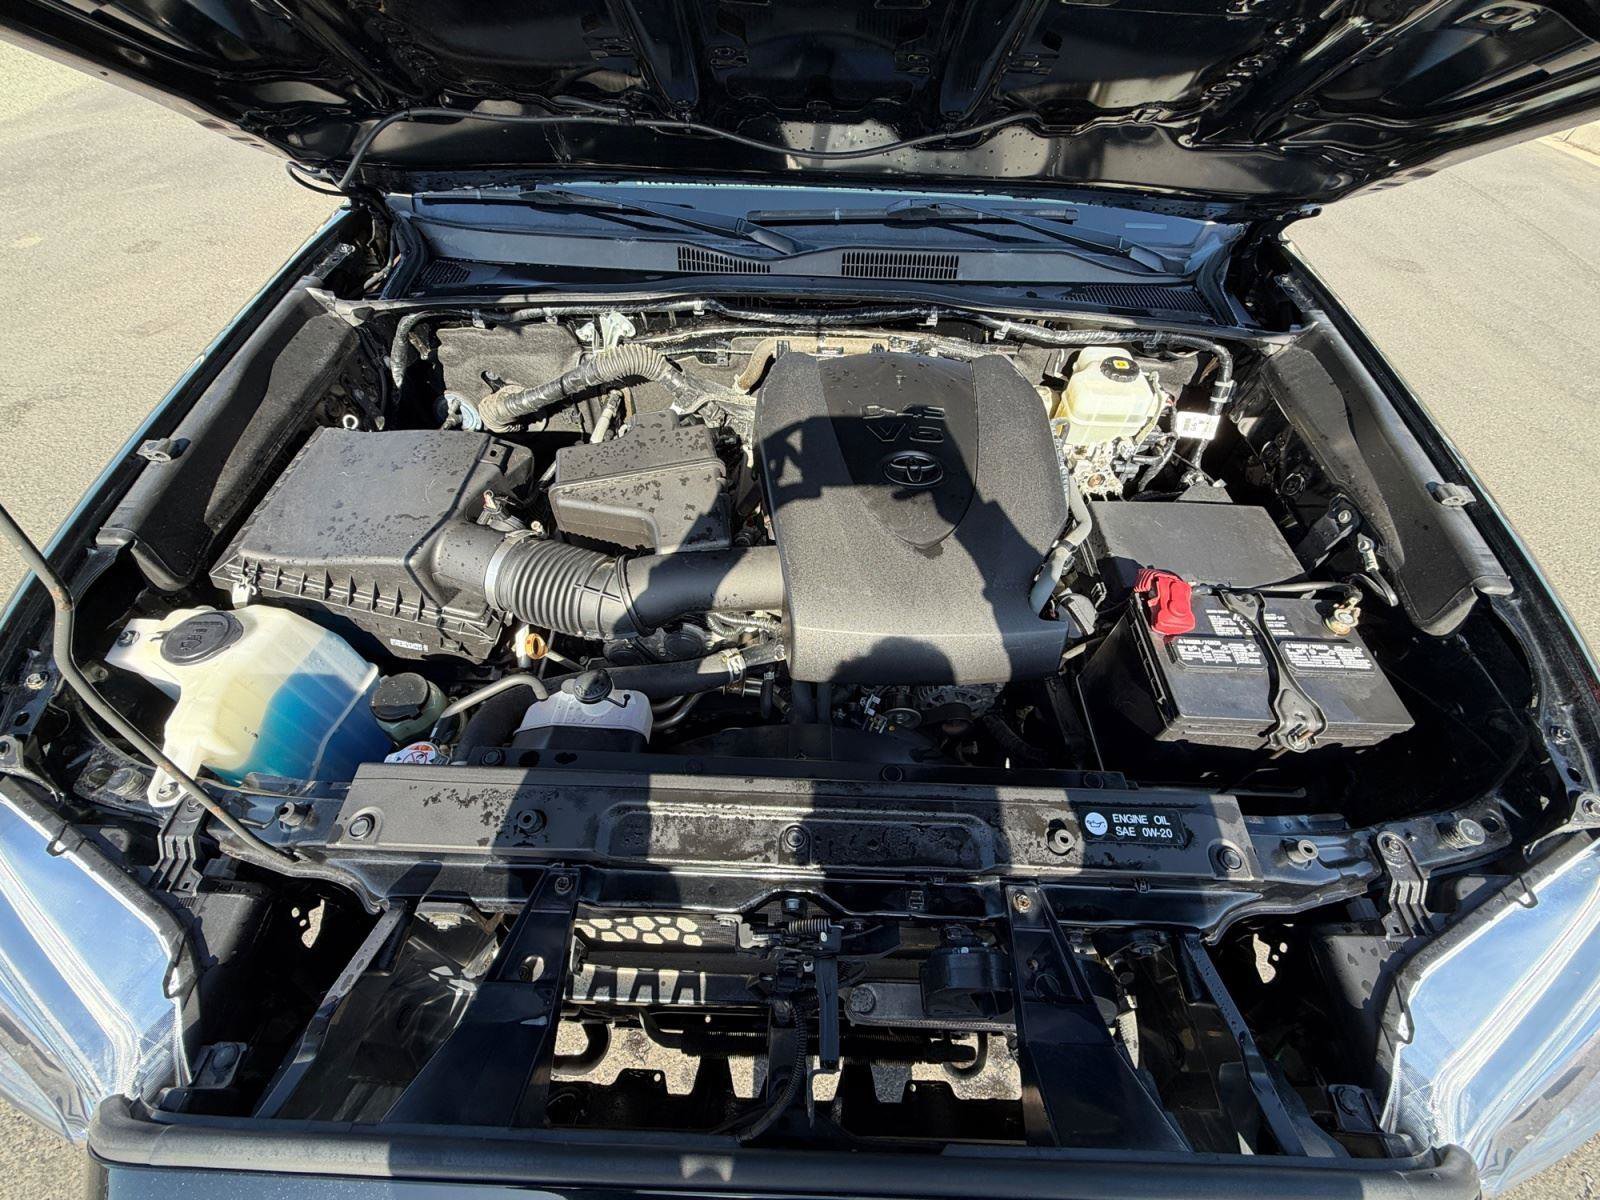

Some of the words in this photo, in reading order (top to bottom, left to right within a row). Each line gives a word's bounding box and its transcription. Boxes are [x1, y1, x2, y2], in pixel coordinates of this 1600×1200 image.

[865, 423, 945, 443] V6
[1112, 813, 1148, 825] ENGINE
[1153, 815, 1171, 826] OIL
[1116, 826, 1137, 837] SAE
[1142, 827, 1173, 838] 0W-20
